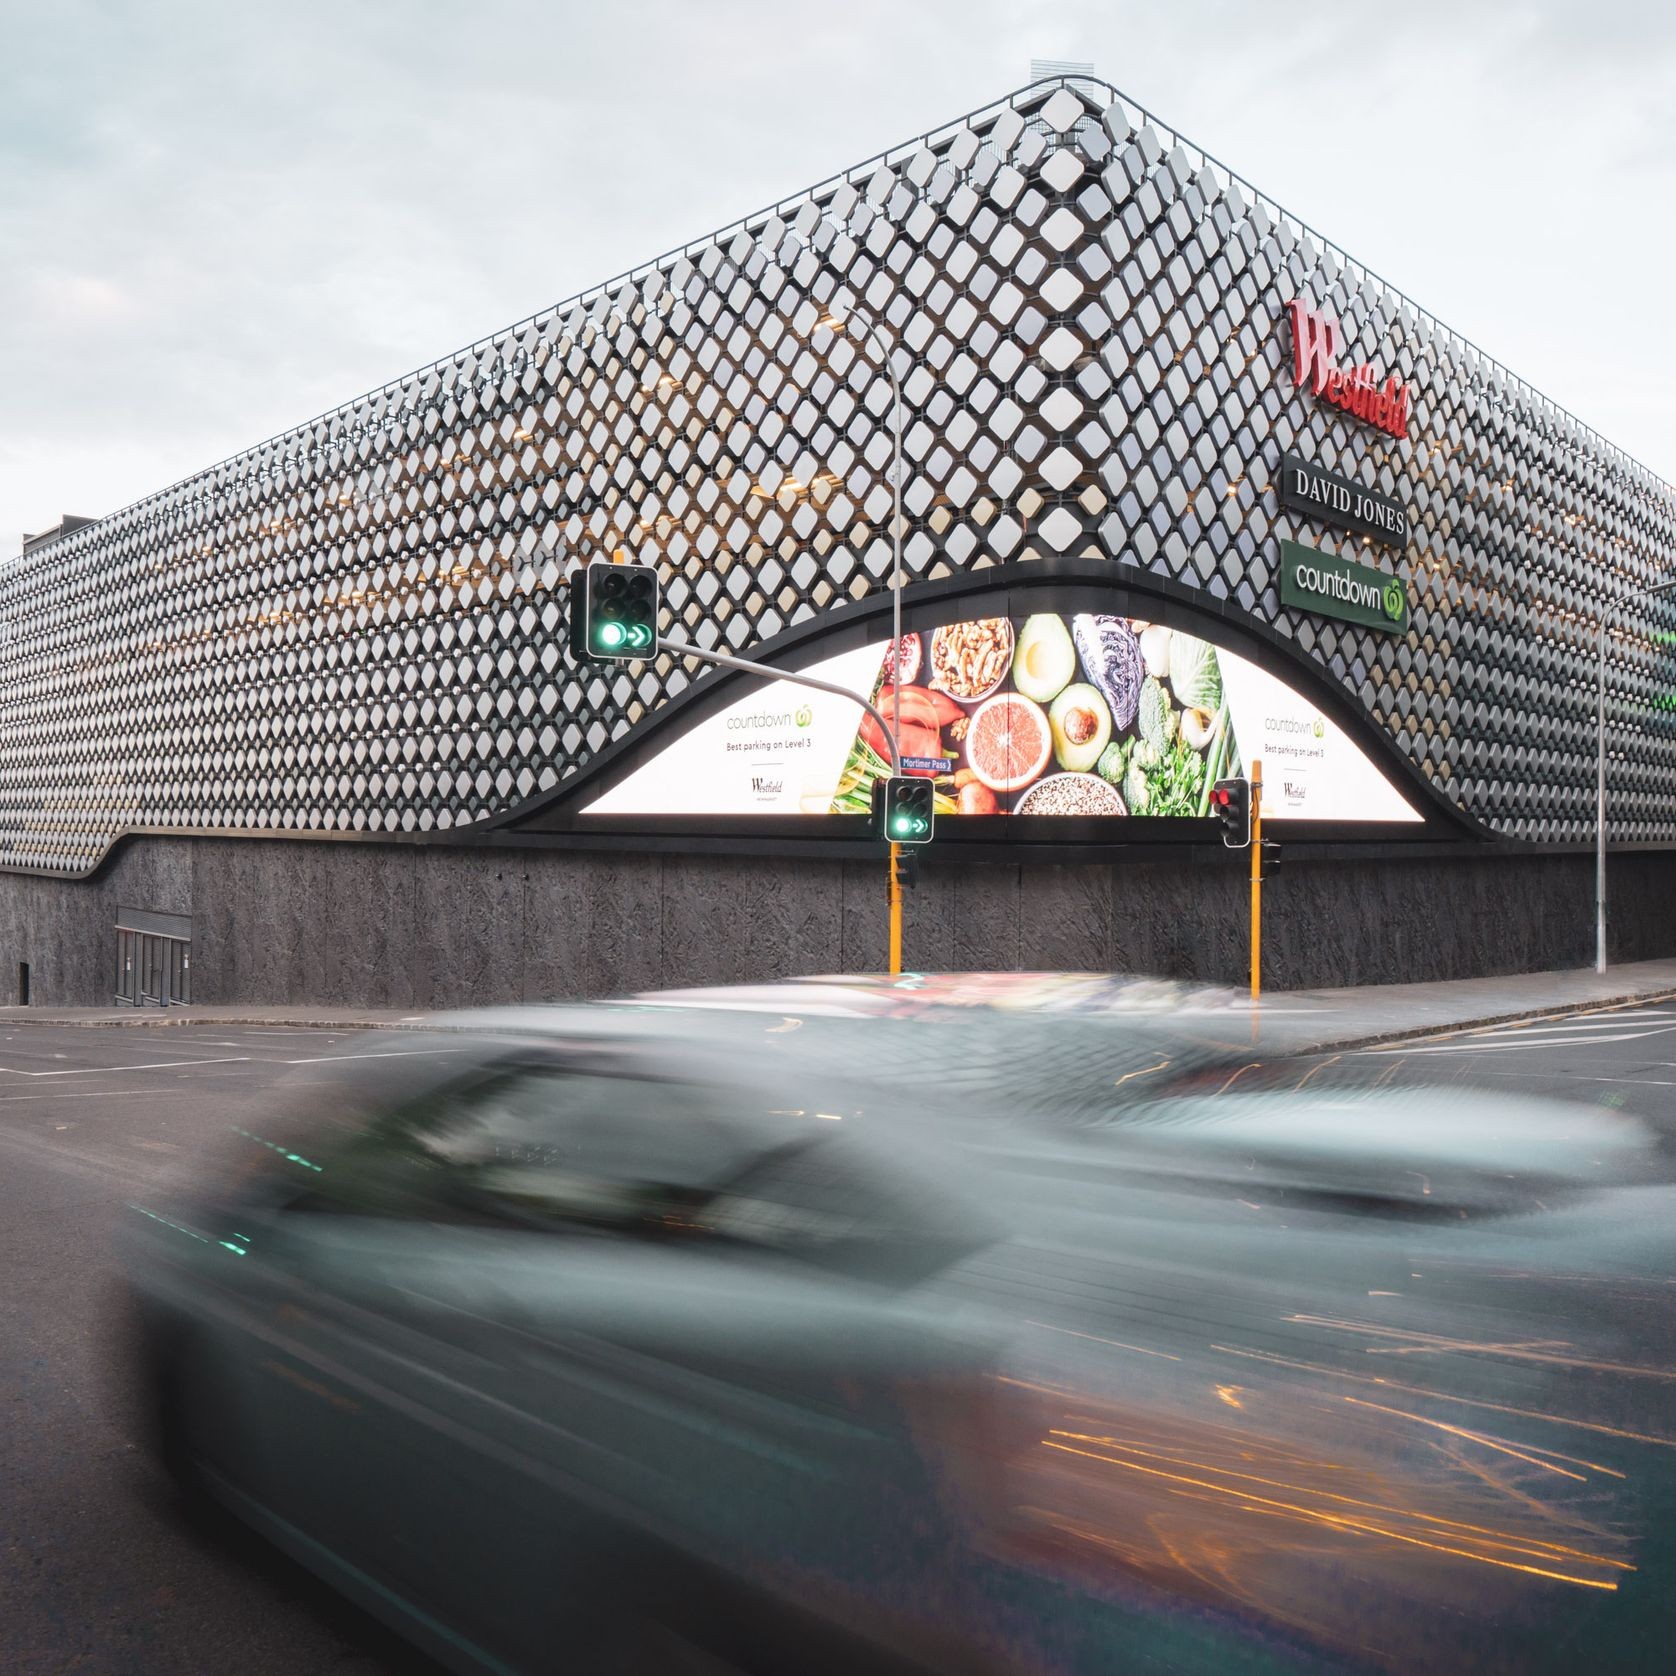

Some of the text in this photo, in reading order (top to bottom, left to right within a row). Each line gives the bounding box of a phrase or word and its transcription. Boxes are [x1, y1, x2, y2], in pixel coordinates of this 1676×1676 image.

[1286, 298, 1411, 439] Westfield
[1296, 468, 1405, 535] DAVID JONES
[1296, 563, 1381, 610] countdown
[726, 710, 792, 730] countdown
[1264, 716, 1312, 734] countdown
[726, 738, 811, 752] Best parking on Level 3
[1265, 743, 1277, 753] Best
[1278, 745, 1298, 758] parking
[1306, 748, 1320, 757] Level
[903, 758, 947, 770] Mortimer Pass
[751, 777, 784, 793] Westfield
